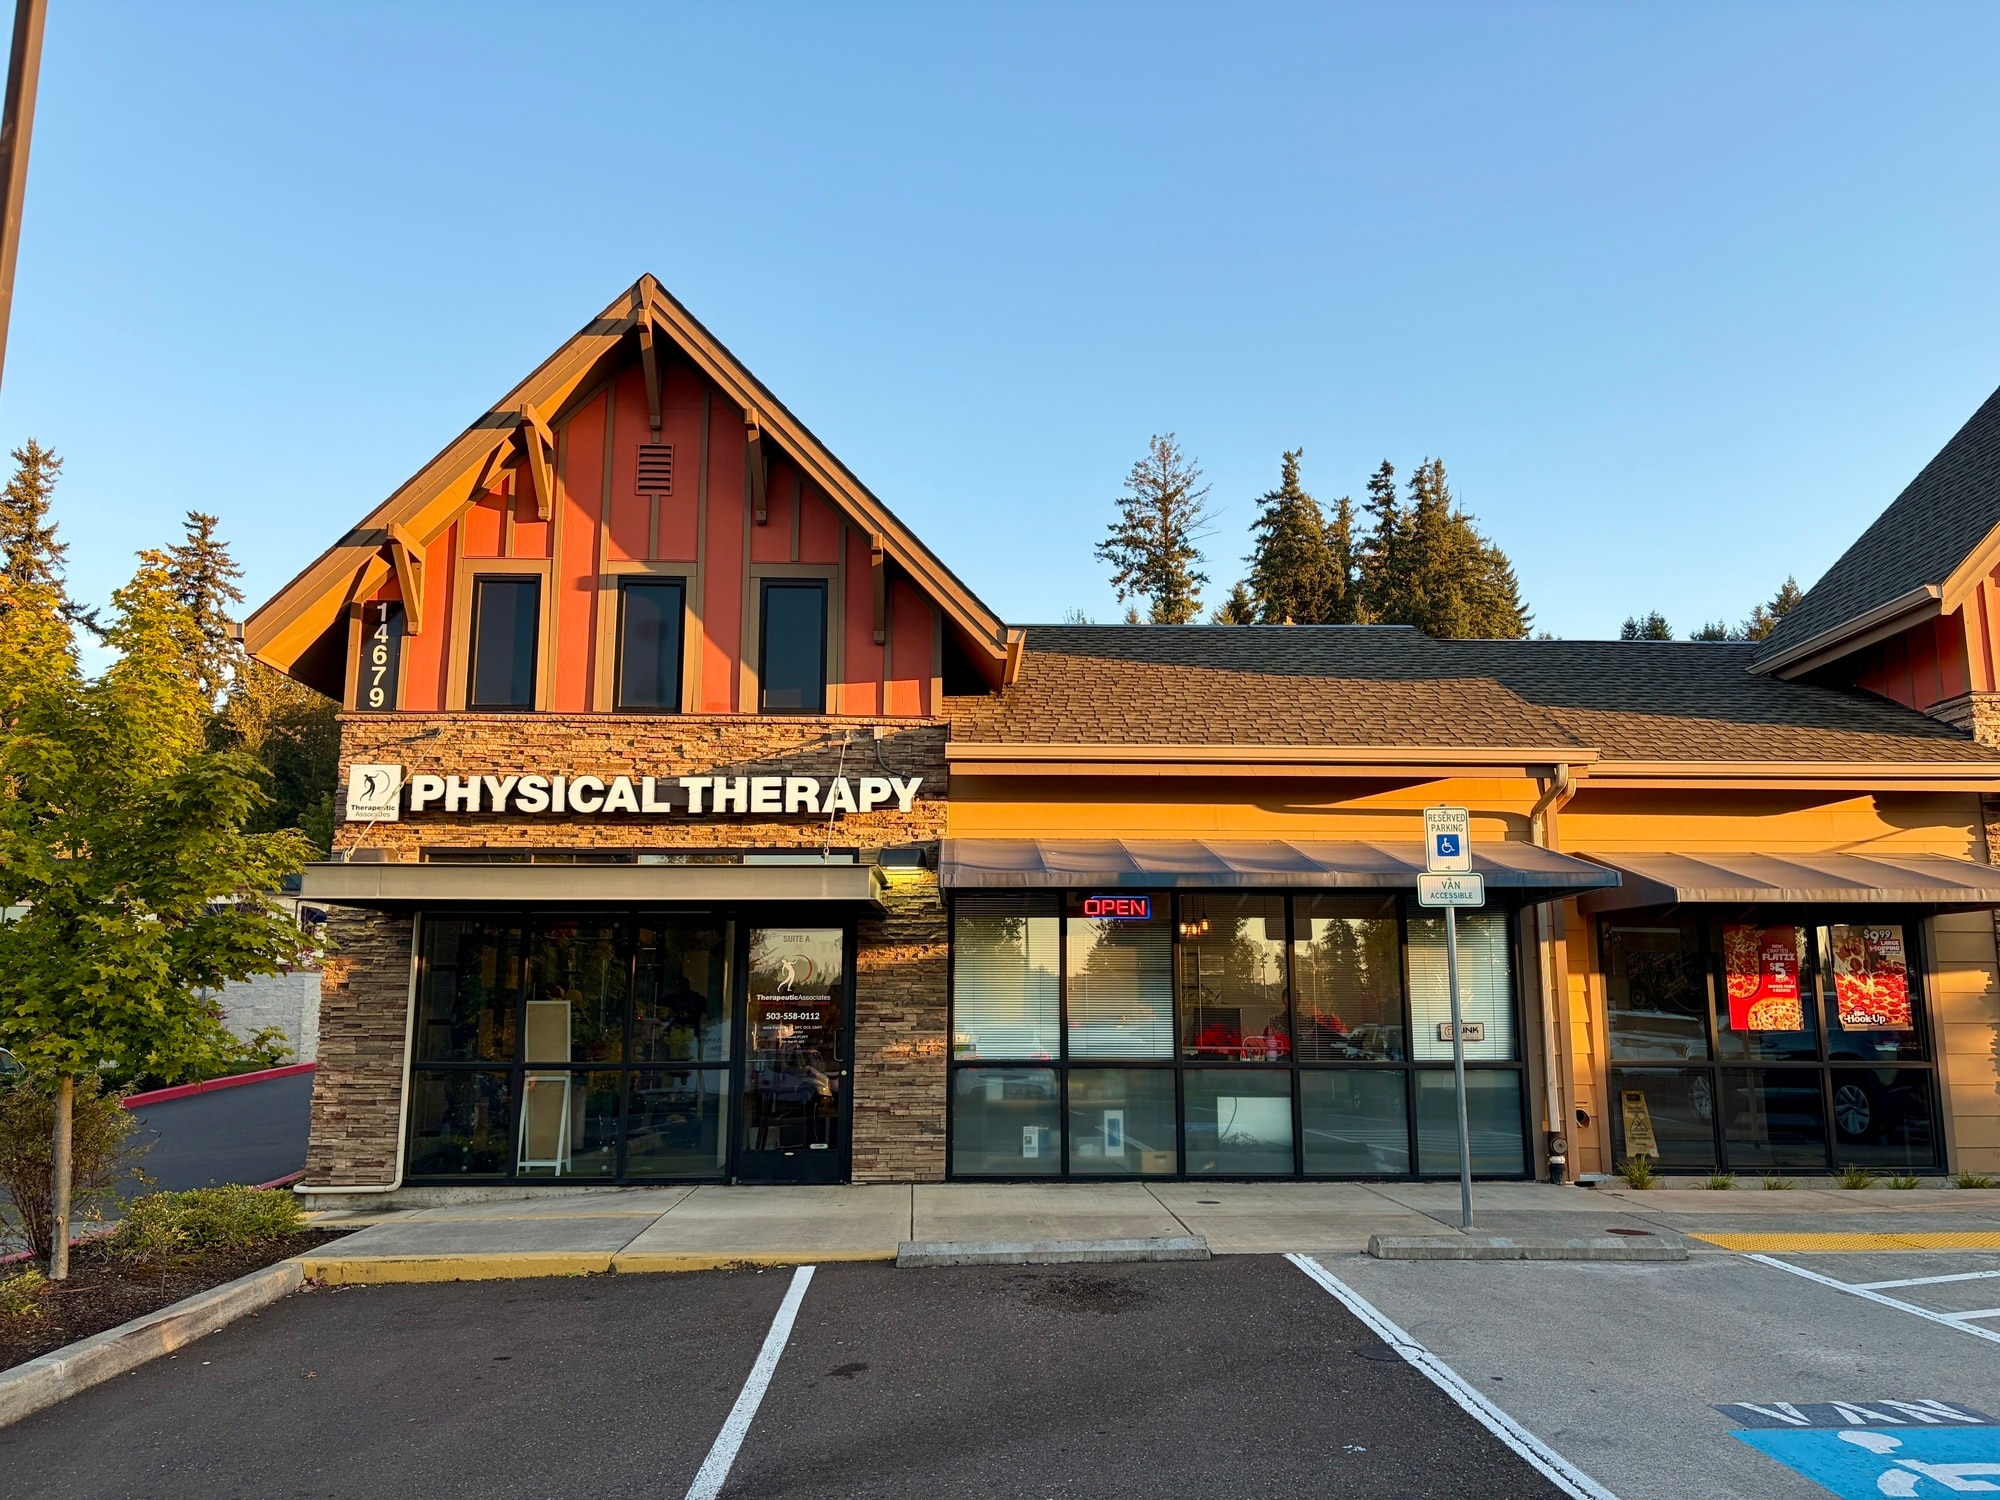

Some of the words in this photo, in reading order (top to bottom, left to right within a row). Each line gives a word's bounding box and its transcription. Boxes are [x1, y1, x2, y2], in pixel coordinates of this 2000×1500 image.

[369, 602, 388, 708] 14679
[410, 775, 671, 814] PHYSICAL
[679, 776, 924, 814] THERAPY
[1428, 813, 1466, 823] RESERVED
[1431, 823, 1464, 833] PARKING
[1441, 881, 1461, 890] VAN
[1430, 891, 1473, 899] ACCESSIBLE
[1084, 899, 1146, 915] OPEN
[783, 935, 803, 943] SUITE
[1762, 953, 1795, 961] FLATZZ
[1769, 962, 1787, 979] $5
[766, 1012, 820, 1020] 503-558-0112
[1733, 1399, 1985, 1426] VAN
